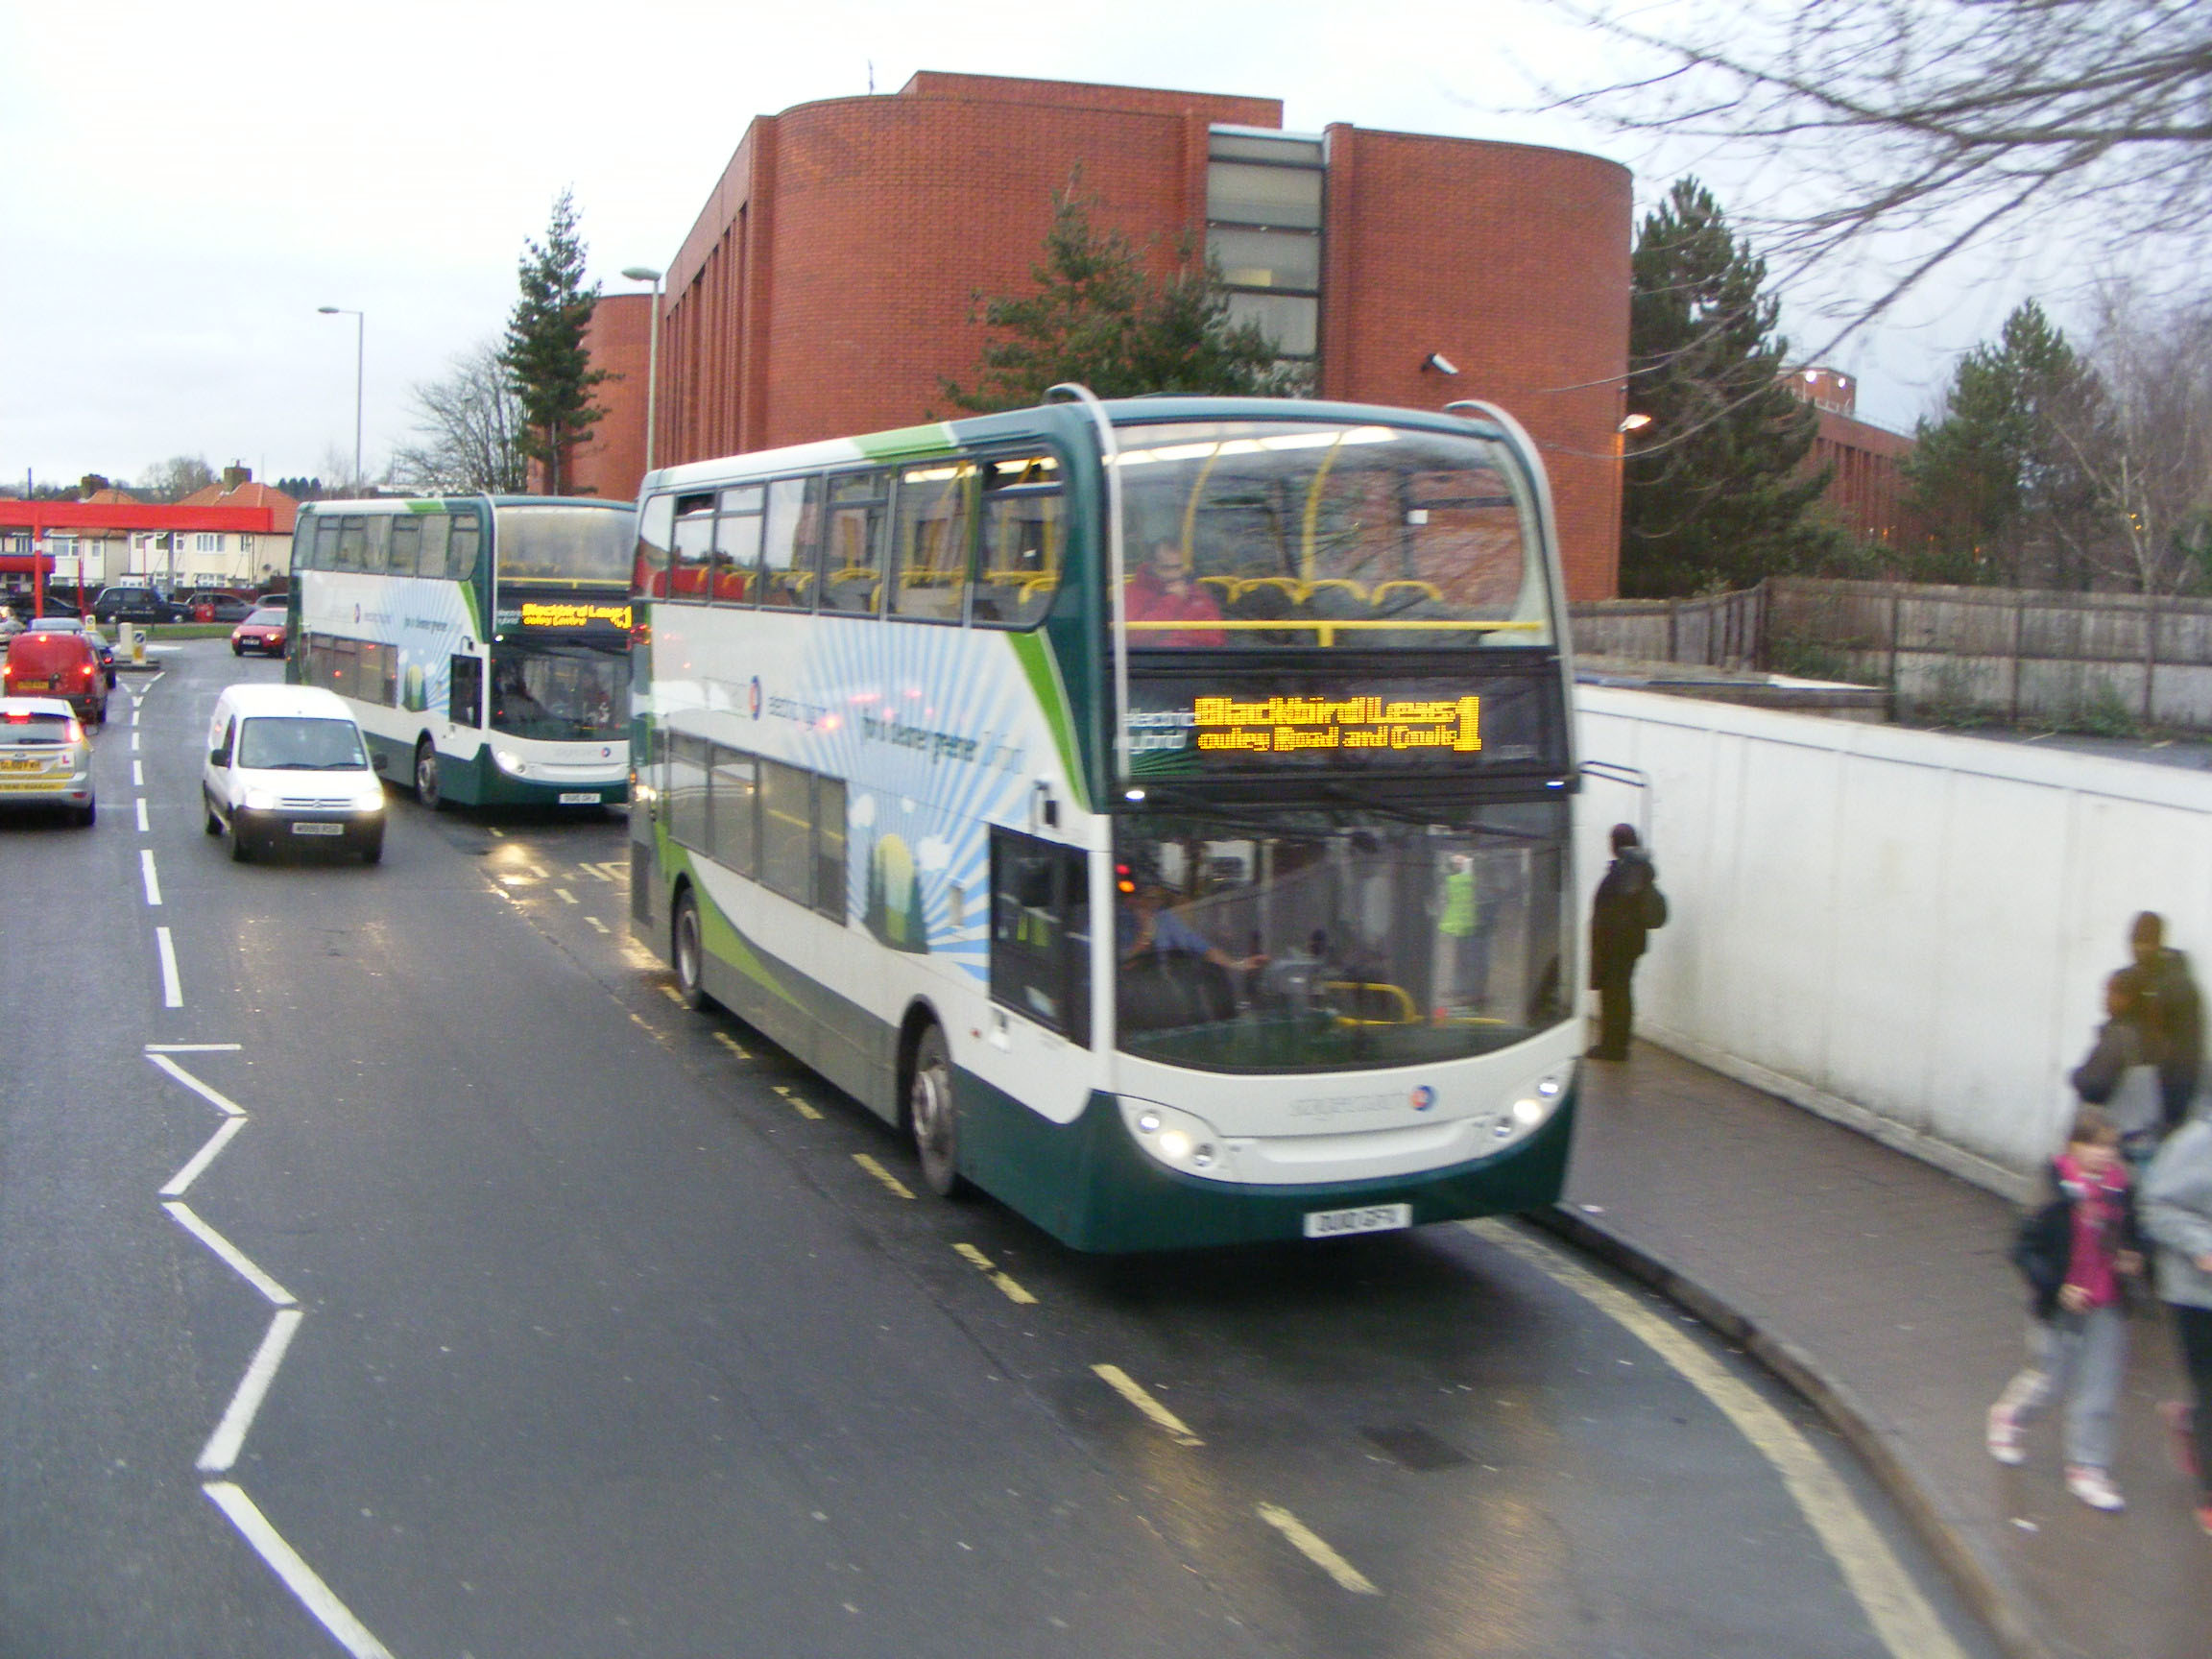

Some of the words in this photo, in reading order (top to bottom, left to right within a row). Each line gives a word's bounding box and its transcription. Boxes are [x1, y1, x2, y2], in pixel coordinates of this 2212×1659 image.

[1194, 697, 1365, 726] Blackbird
[1454, 696, 1482, 752] 1
[1342, 725, 1389, 748] and
